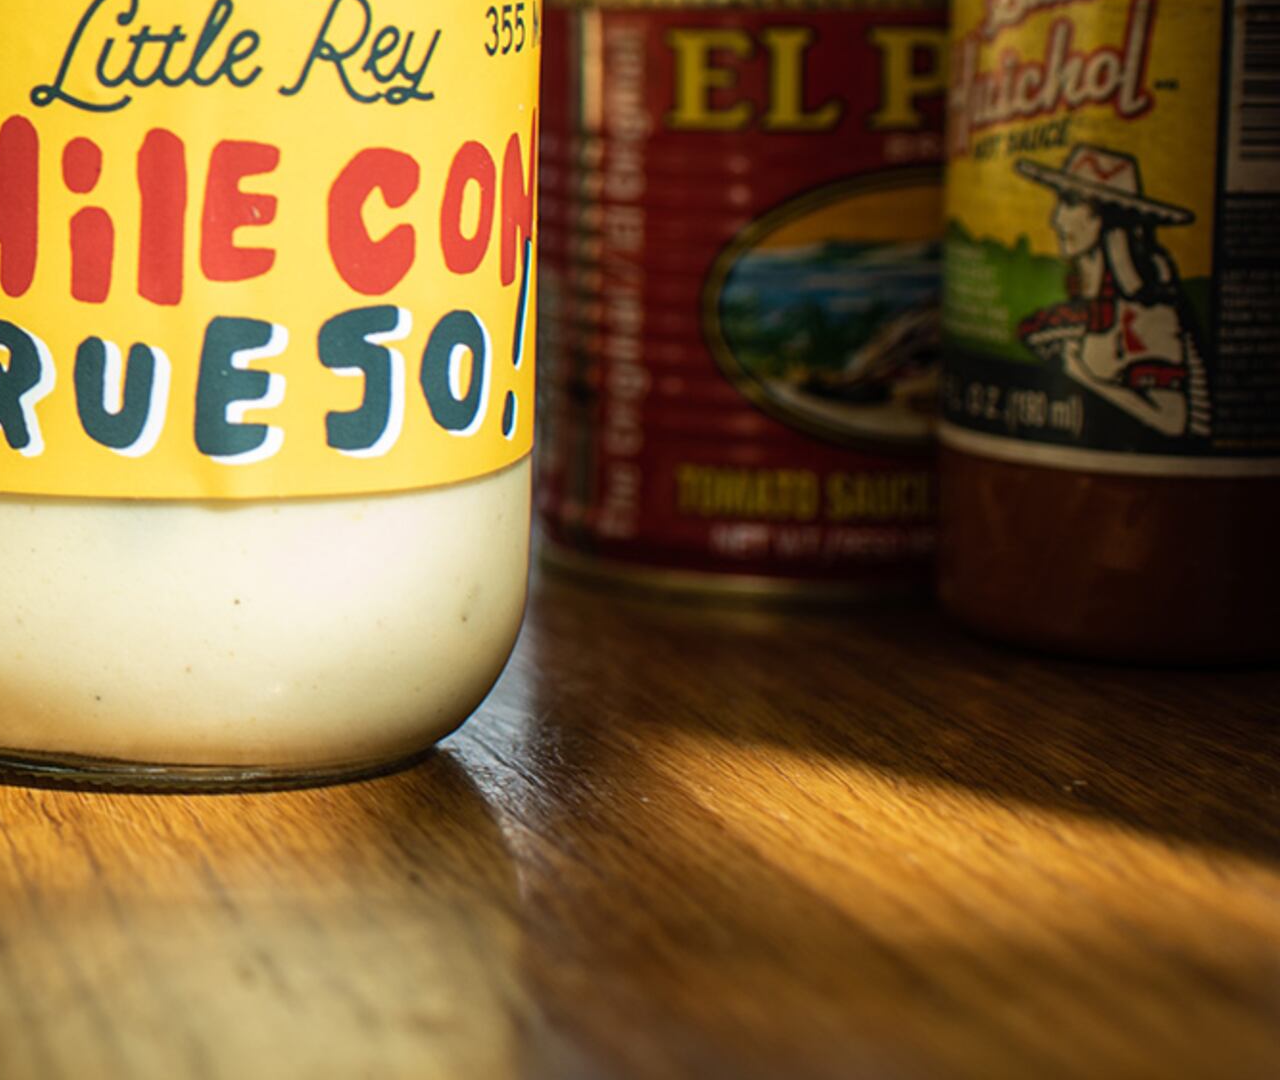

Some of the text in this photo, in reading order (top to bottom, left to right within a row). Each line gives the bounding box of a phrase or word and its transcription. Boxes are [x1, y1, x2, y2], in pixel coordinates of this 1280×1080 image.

[484, 1, 525, 57] 355
[664, 24, 951, 130] EL P
[326, 107, 537, 296] CON
